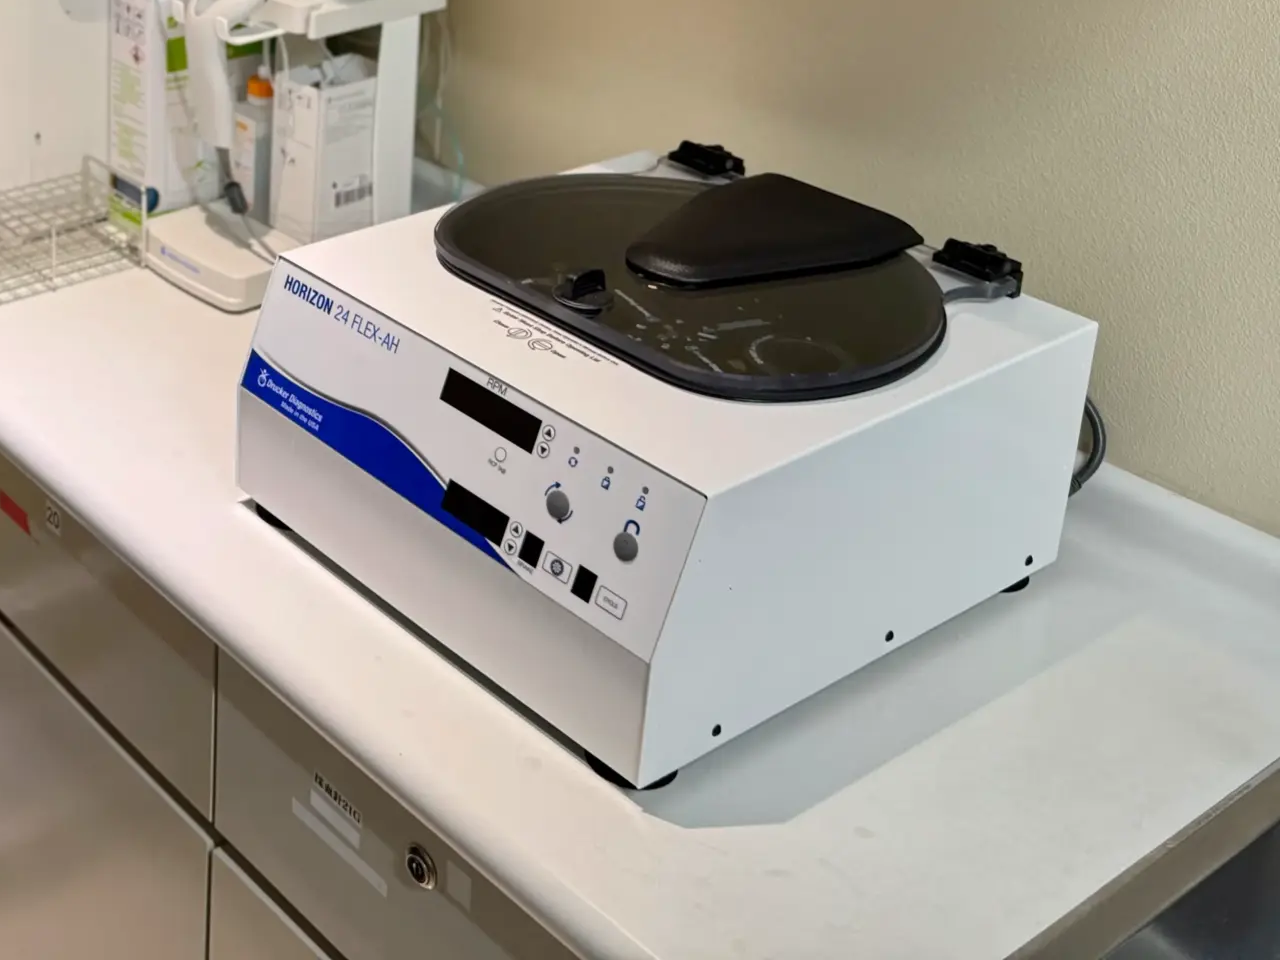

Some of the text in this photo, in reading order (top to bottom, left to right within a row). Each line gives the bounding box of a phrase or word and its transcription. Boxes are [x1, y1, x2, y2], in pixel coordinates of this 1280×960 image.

[284, 274, 401, 354] HORIZON 24 FLEX-AH
[266, 378, 324, 423] Drucker Diagnostics
[486, 376, 508, 396] RPM
[280, 401, 294, 414] Made
[299, 414, 308, 423] the
[307, 419, 320, 432] USA
[47, 506, 60, 529] 20
